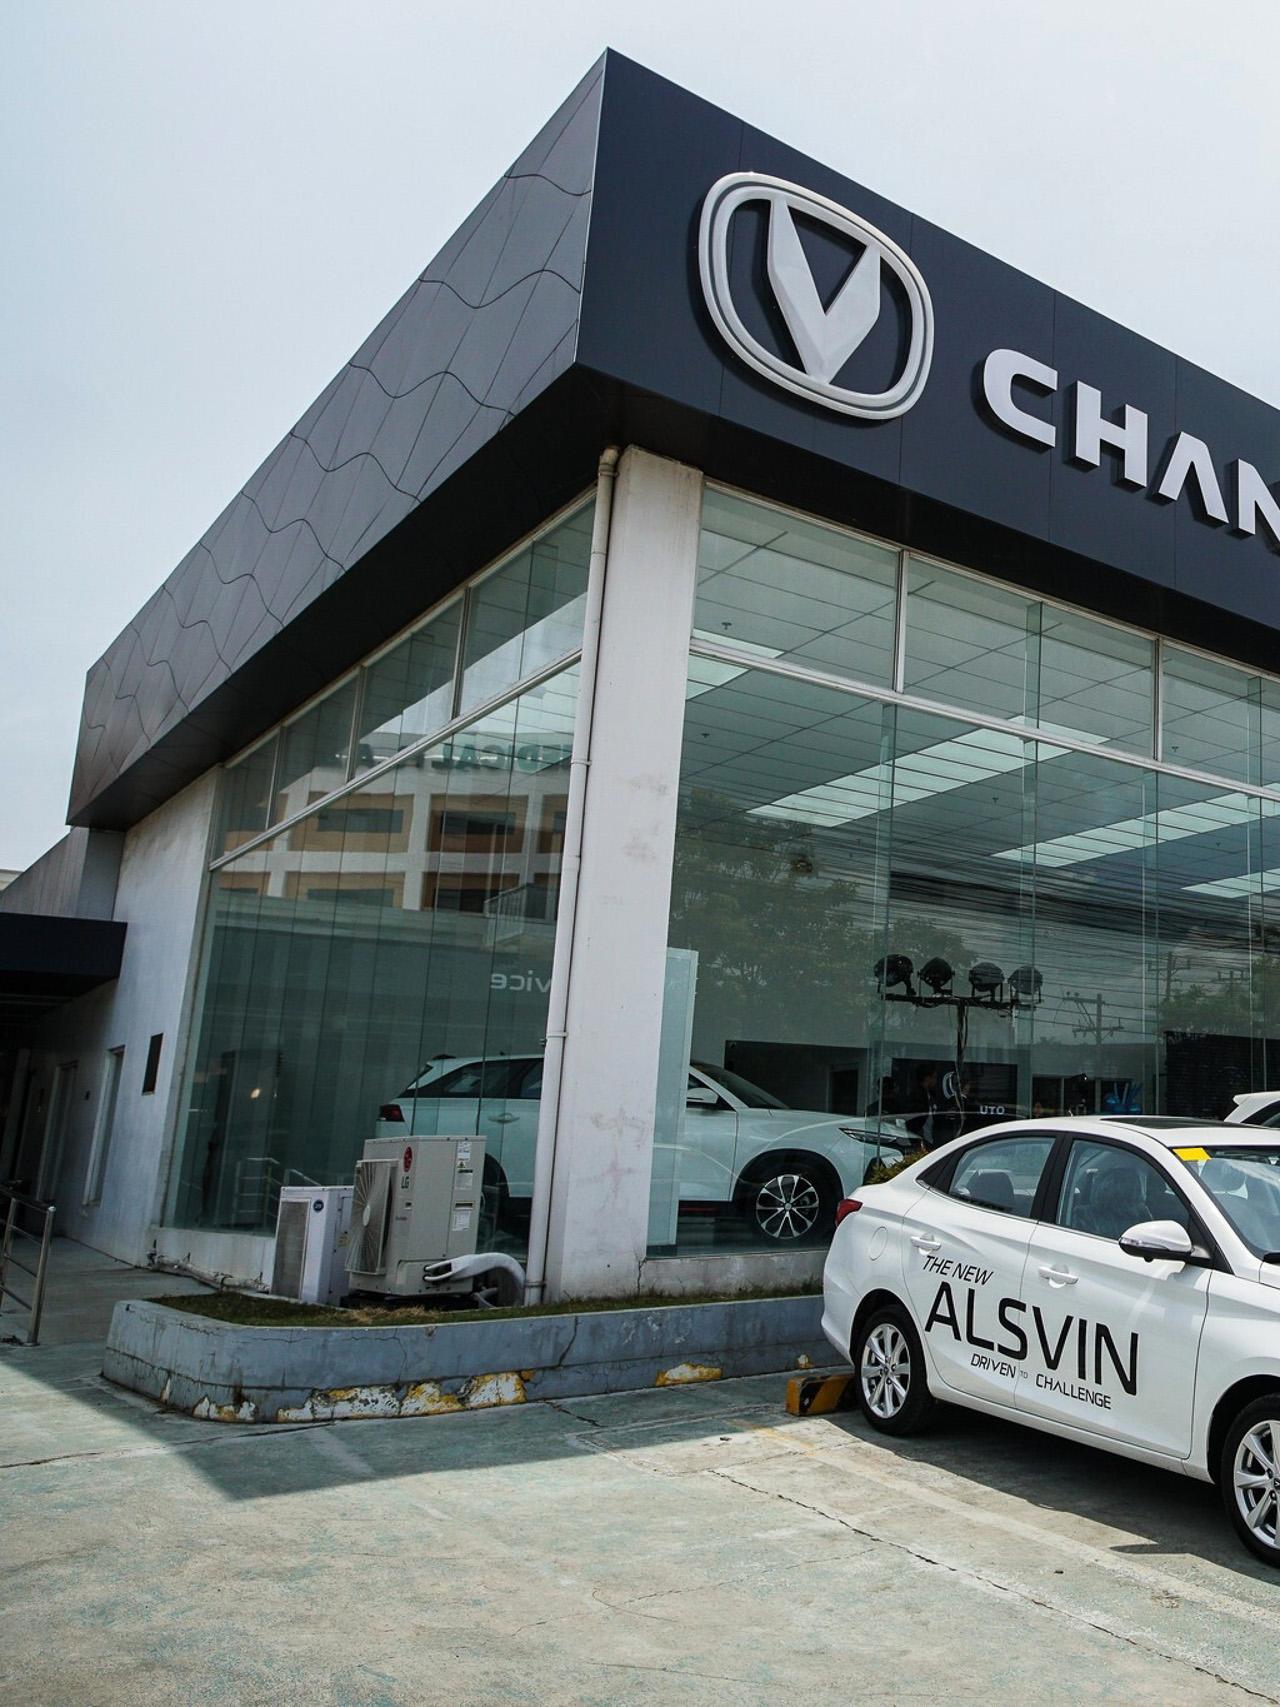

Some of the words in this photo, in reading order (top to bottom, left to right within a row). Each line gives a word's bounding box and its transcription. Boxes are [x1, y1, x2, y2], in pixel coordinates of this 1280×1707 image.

[401, 1176, 410, 1189] LG
[921, 1255, 953, 1275] THE
[951, 1263, 994, 1285] NEW
[924, 1281, 1139, 1396] ALSVIN
[970, 1353, 1016, 1378] DRIVEN
[1036, 1373, 1112, 1409] CHALLENGE
